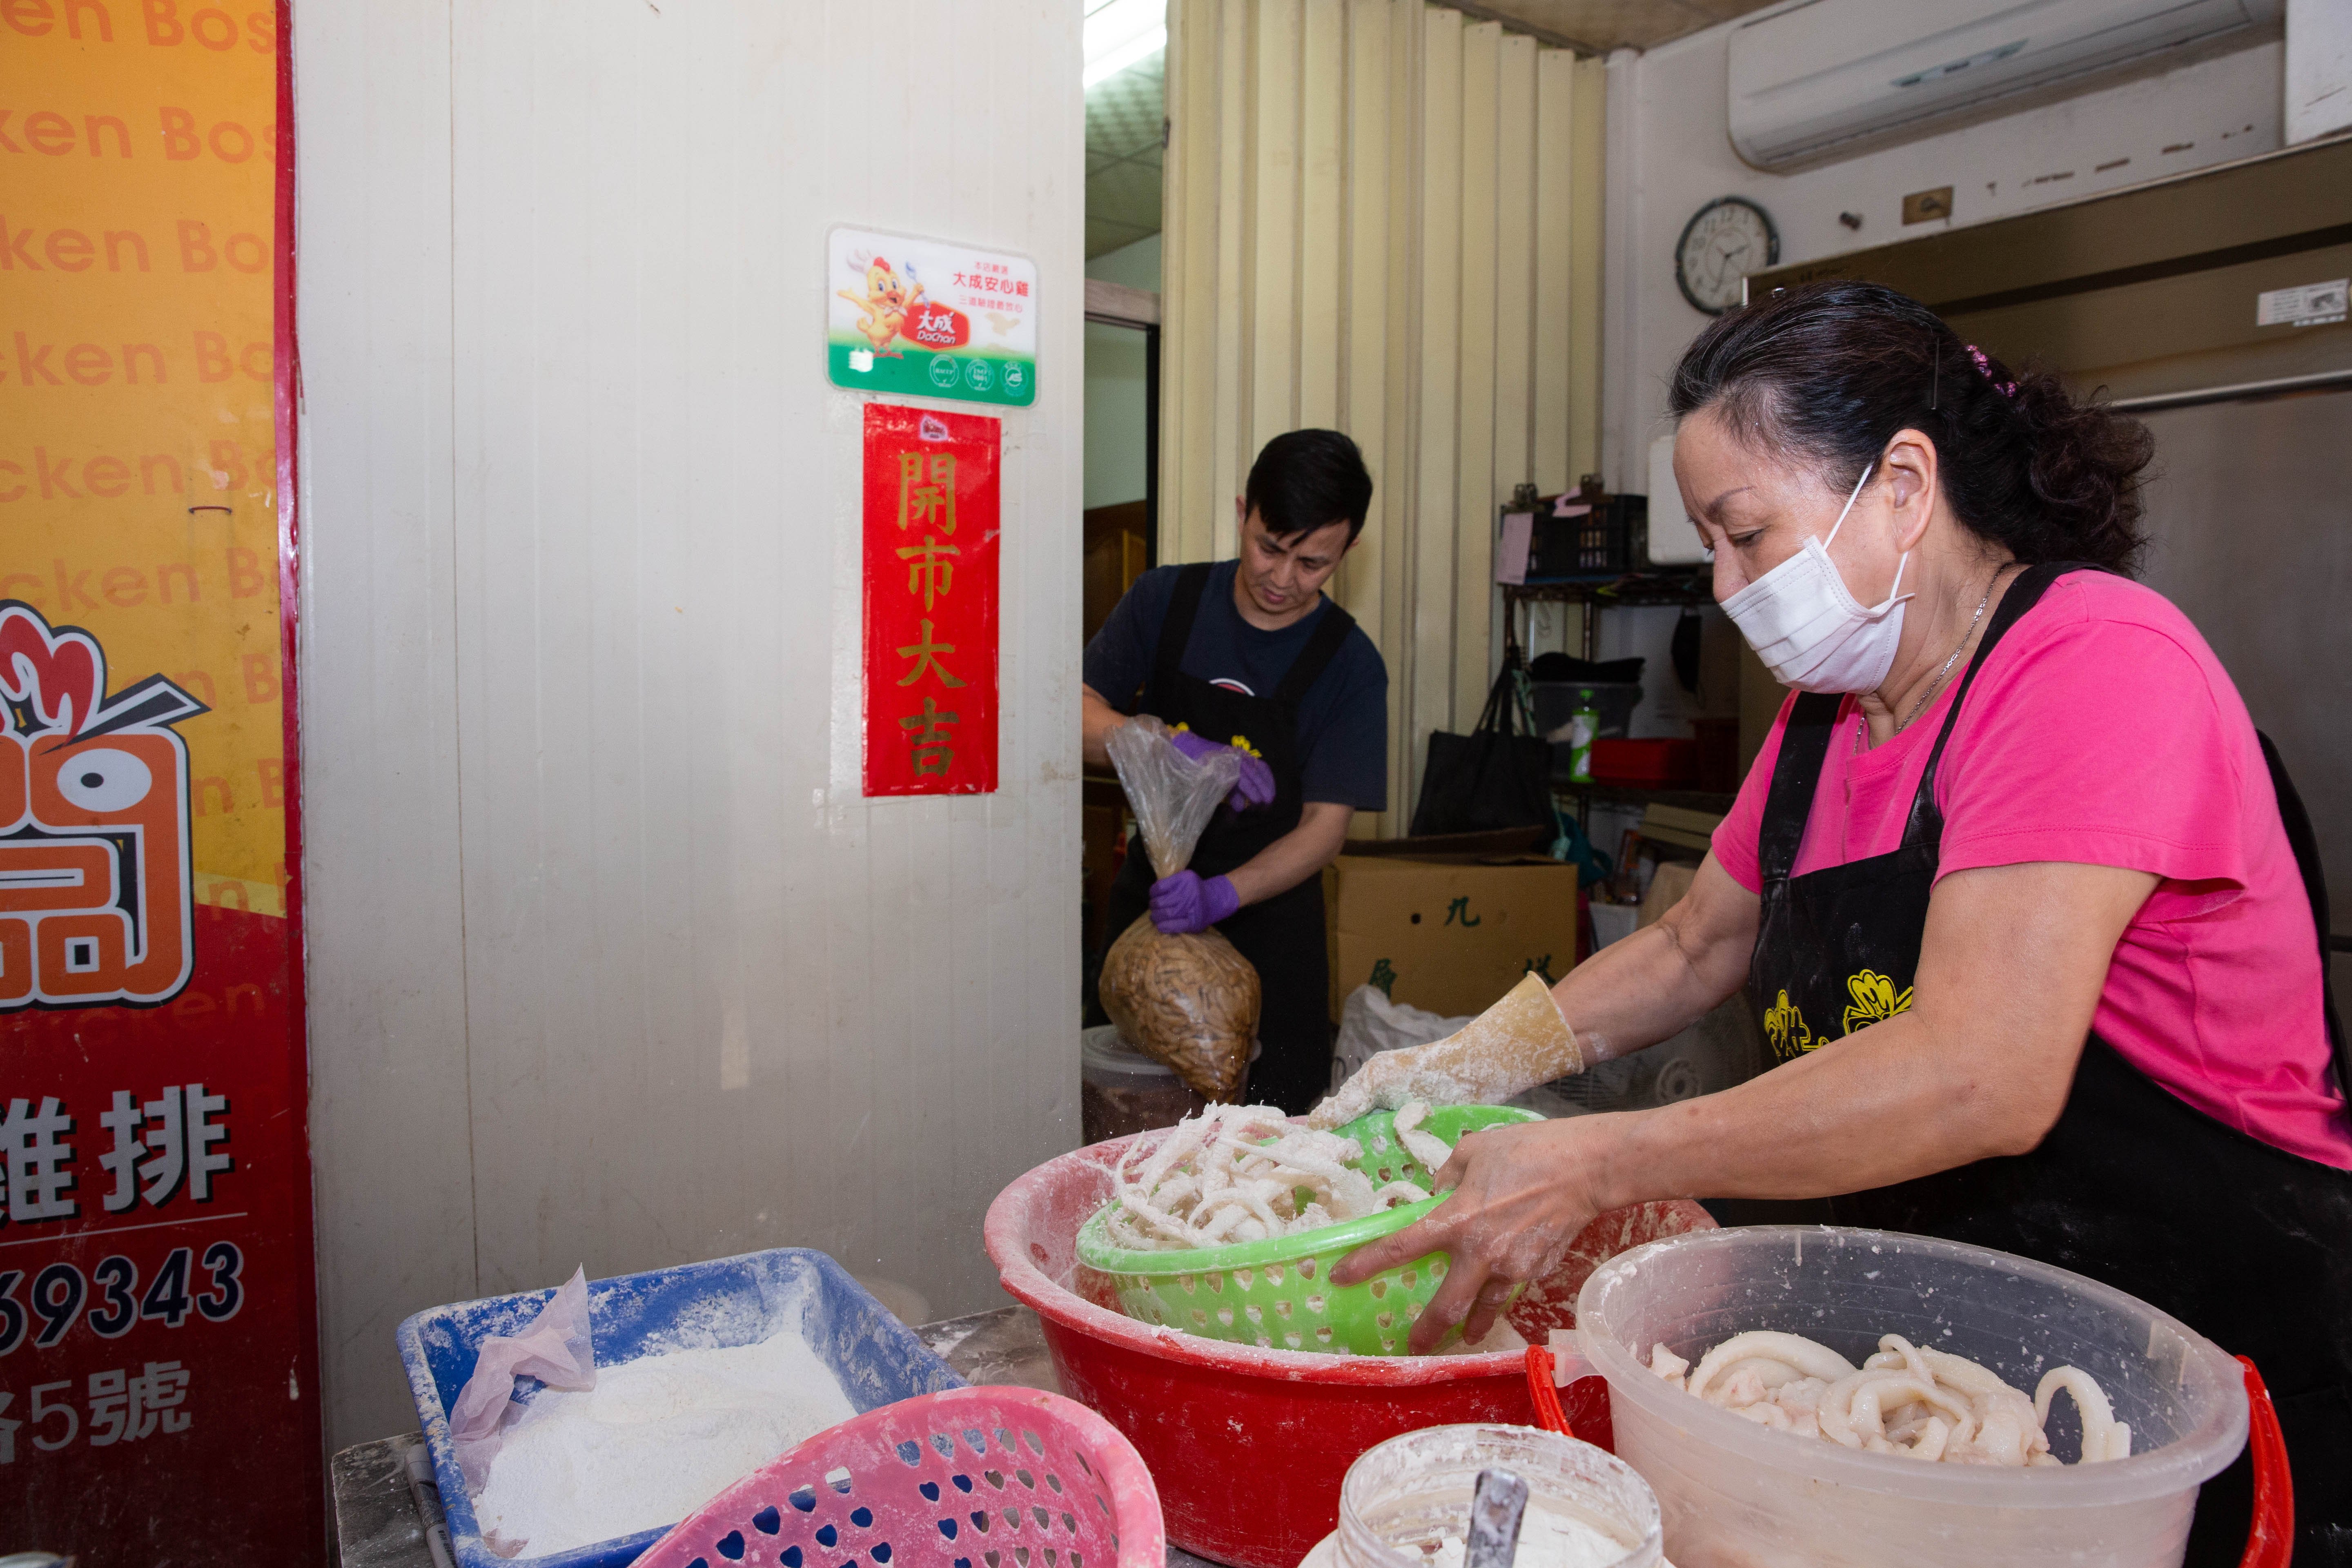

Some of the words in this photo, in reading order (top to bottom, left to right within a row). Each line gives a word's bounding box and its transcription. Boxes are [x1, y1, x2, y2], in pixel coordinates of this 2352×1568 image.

[176, 219, 270, 274] Bo
[917, 311, 956, 334] 大成
[896, 451, 968, 778] 開市大吉
